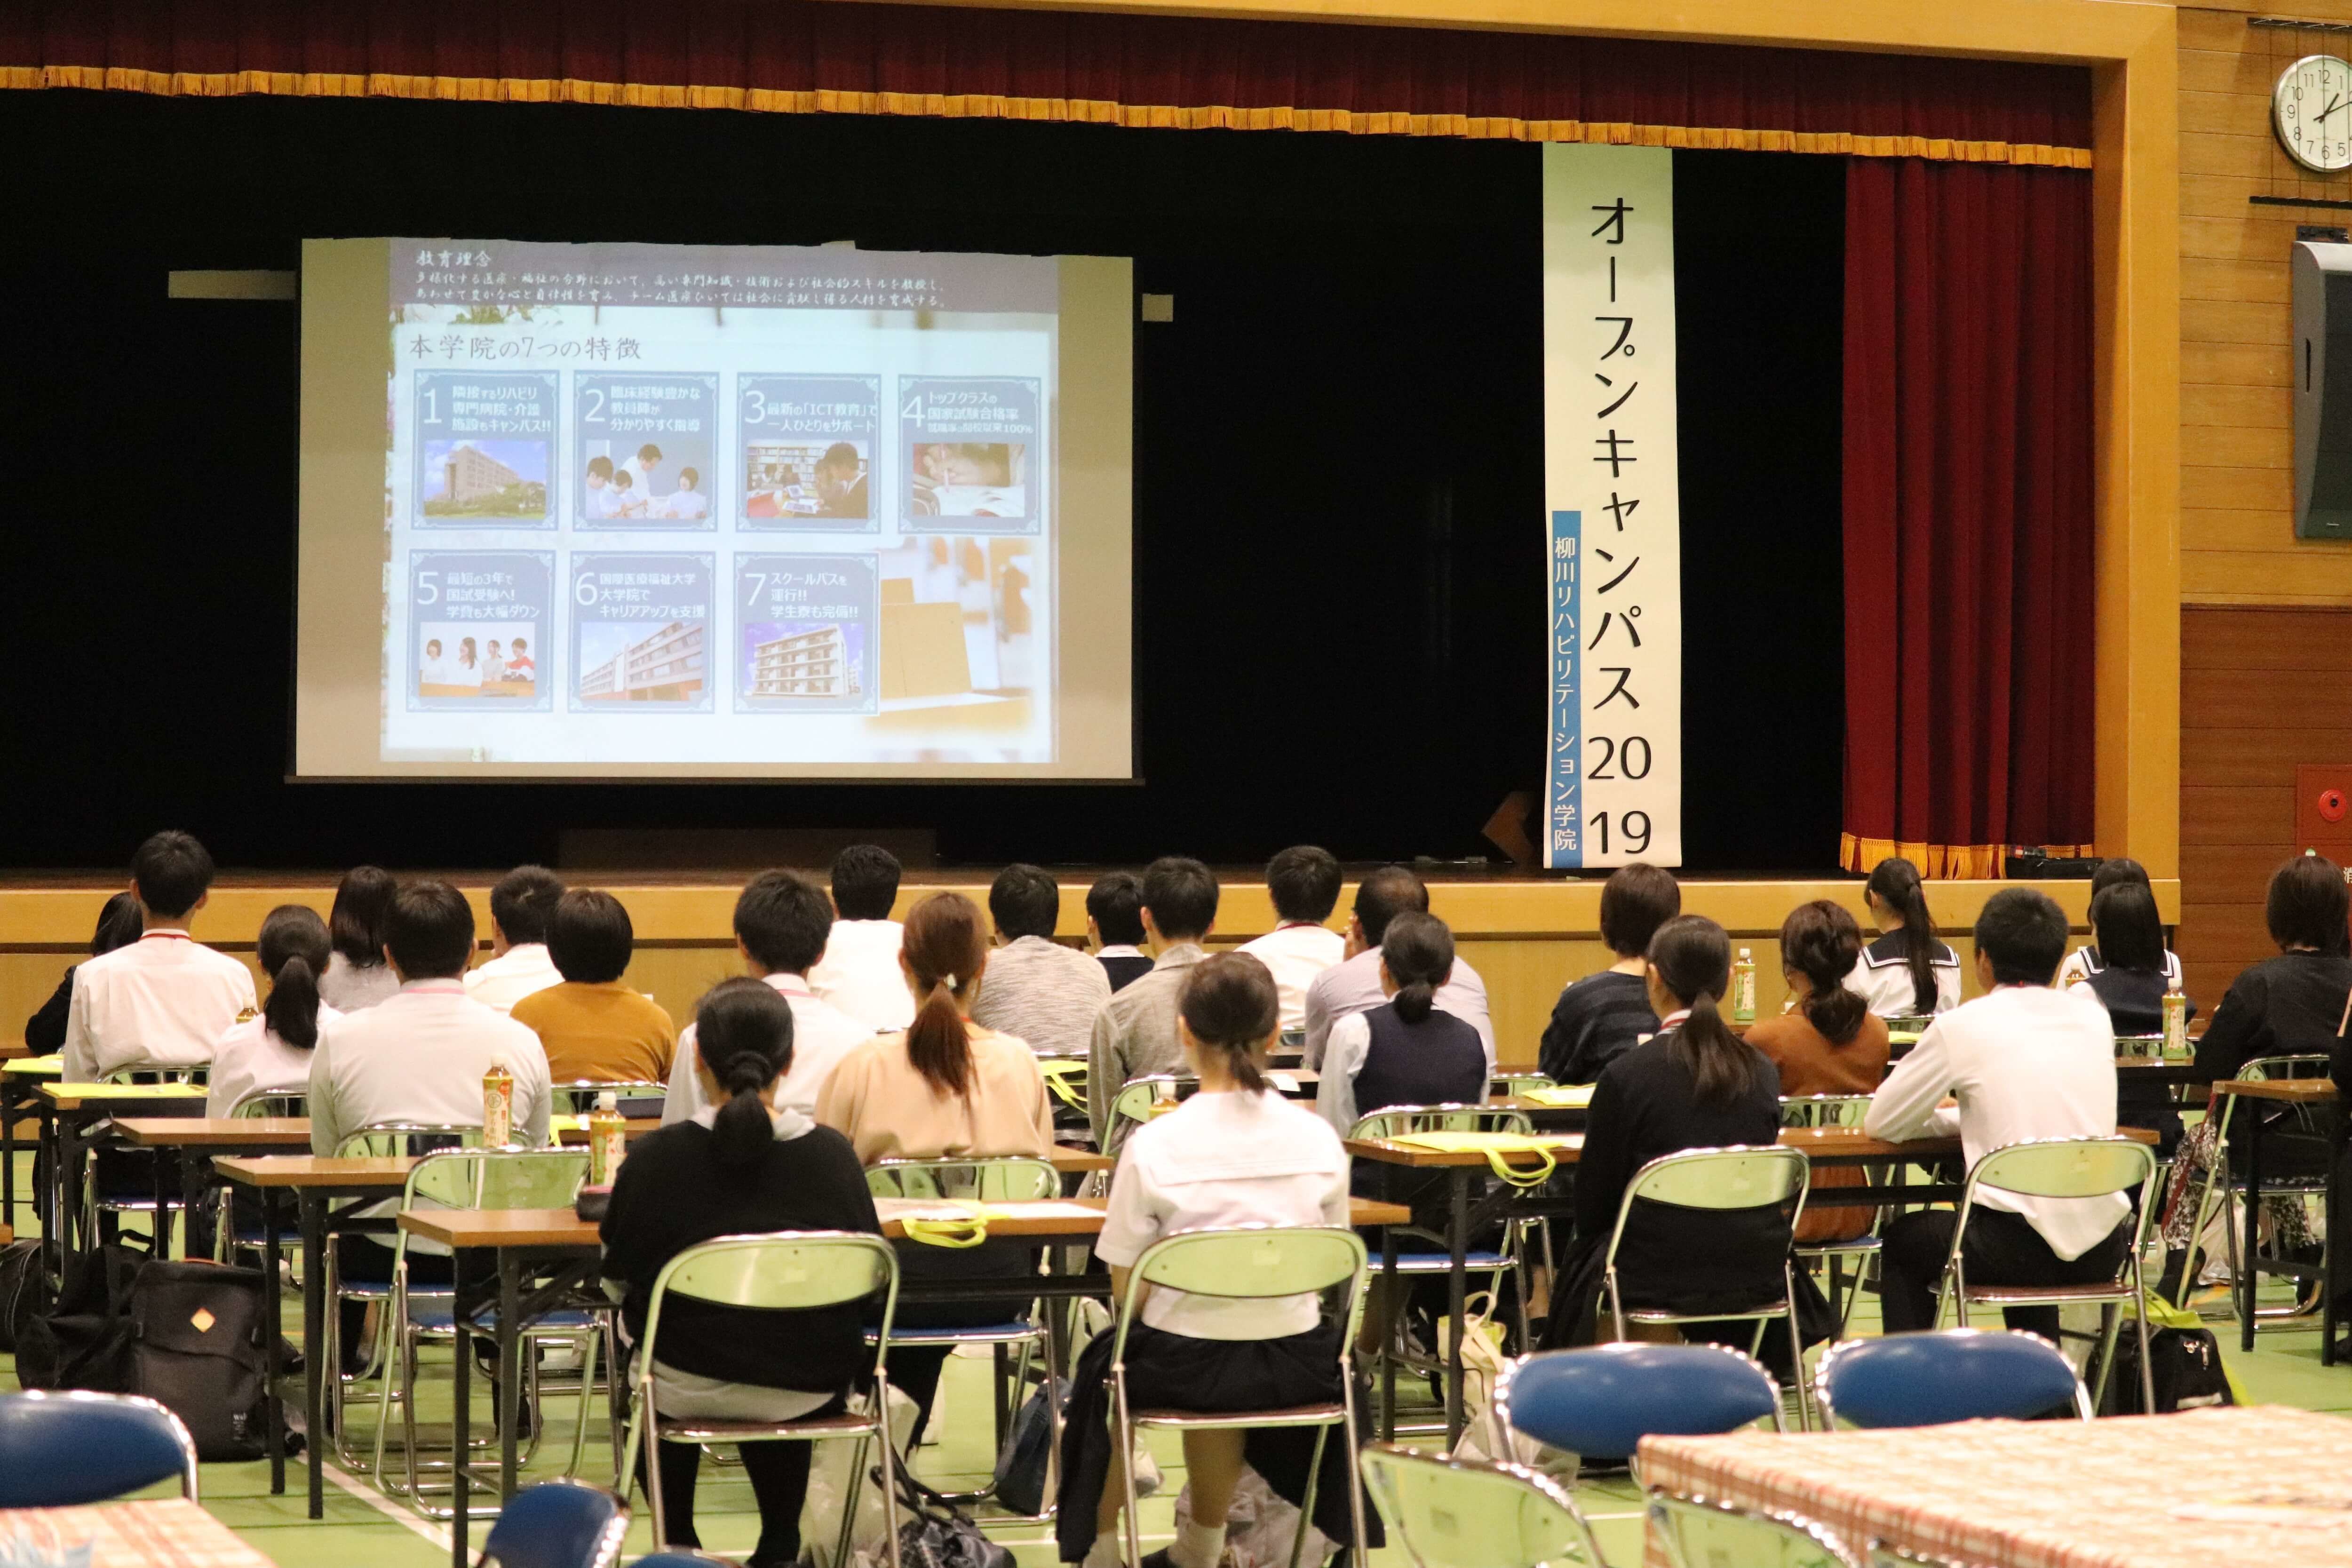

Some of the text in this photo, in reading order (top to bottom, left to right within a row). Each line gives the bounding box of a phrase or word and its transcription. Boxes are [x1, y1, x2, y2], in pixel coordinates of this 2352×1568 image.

[2304, 74, 2313, 88] 11
[2318, 70, 2330, 84] 12
[2339, 75, 2343, 89] 1
[2292, 86, 2304, 101] 10
[2287, 104, 2296, 119] 9
[2294, 126, 2301, 141] 8
[2307, 140, 2314, 154] 7
[2321, 145, 2330, 159] 6
[2338, 143, 2345, 157] 5
[415, 250, 492, 268] 教育理念
[409, 333, 643, 361] 本学院の7つの特徴
[929, 391, 998, 404] トップクラスの
[423, 388, 442, 424] 1
[585, 388, 605, 422] 2
[744, 390, 765, 423] 3
[901, 395, 926, 428] 4
[928, 407, 1019, 421] 国家試験合格率
[610, 418, 700, 432] 分かりやすく指導
[1588, 197, 1652, 854] オープンキャンパス2019
[447, 572, 513, 586] 最短の3年で
[599, 573, 697, 585] 国際医療福祉大学
[771, 573, 848, 586] スクールバスを
[417, 571, 439, 605] 5
[575, 572, 598, 606] 6
[600, 588, 651, 602] 大学院で
[745, 573, 767, 606] 7
[446, 604, 541, 618] 学費も大幅ダウン
[599, 605, 706, 618] キャリアアップを支援
[1554, 536, 1577, 851] 柳川リハビリテーション学院
